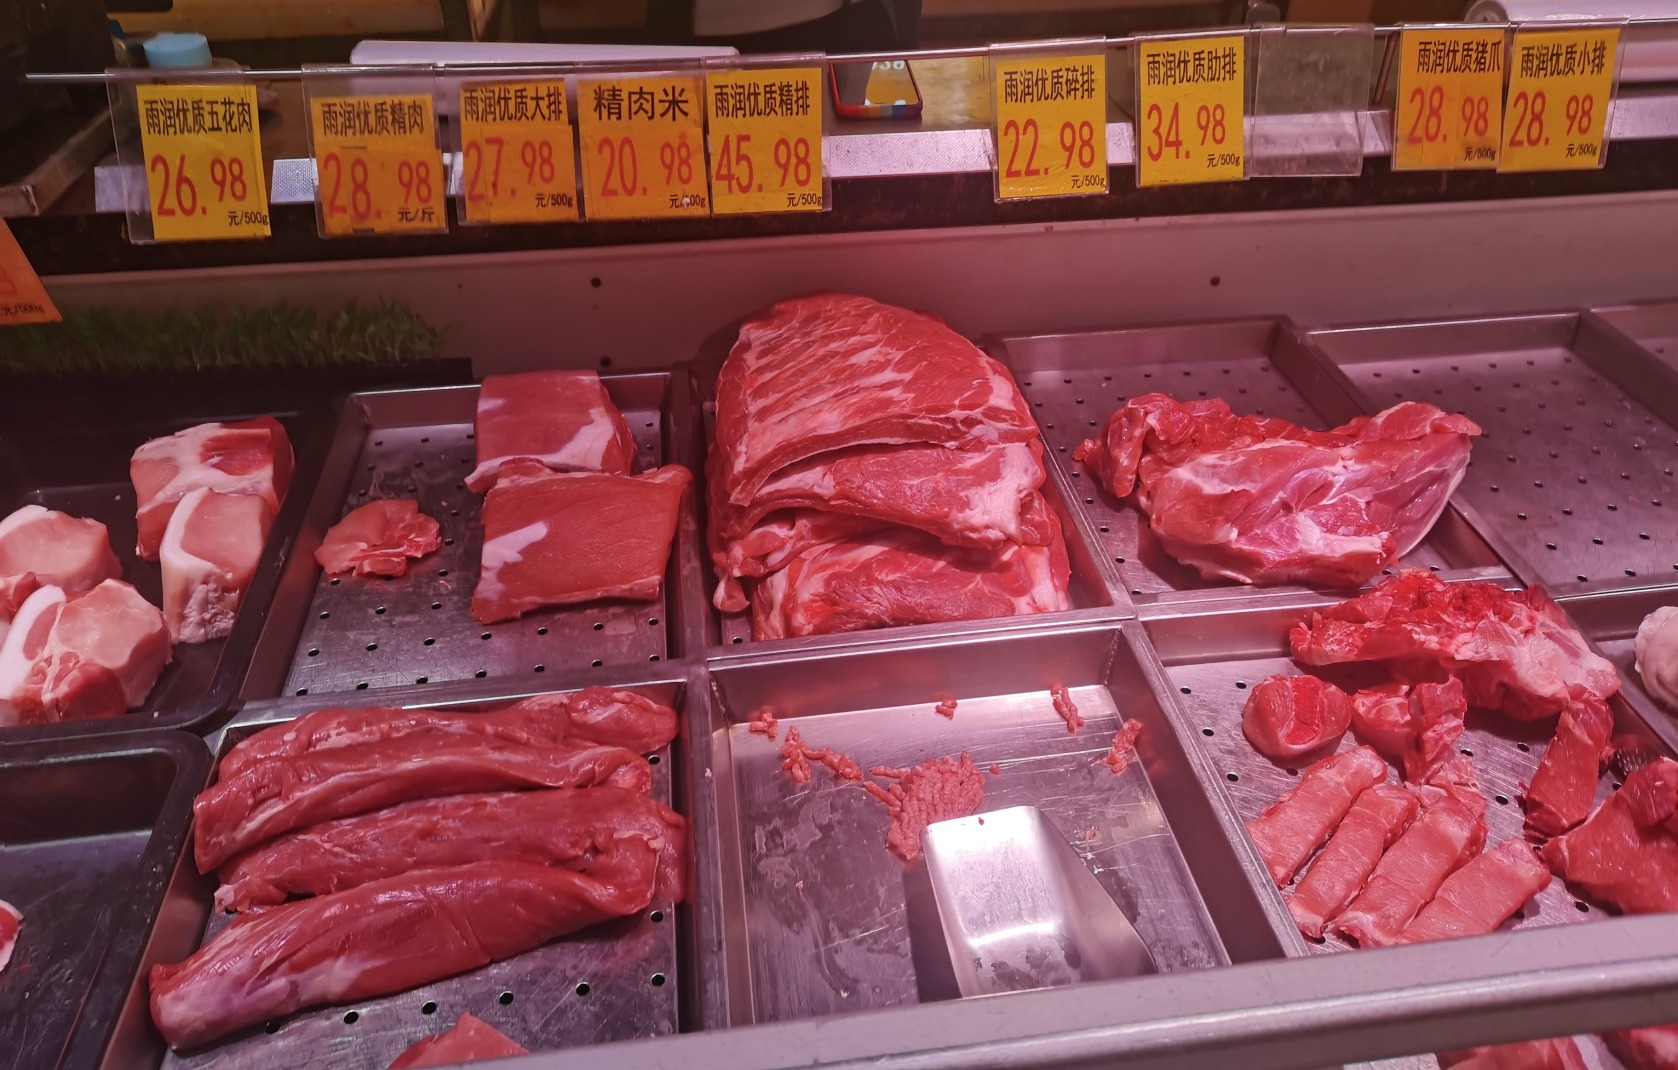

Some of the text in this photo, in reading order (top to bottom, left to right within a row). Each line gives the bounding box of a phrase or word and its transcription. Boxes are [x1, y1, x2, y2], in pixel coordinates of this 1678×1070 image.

[1147, 47, 1237, 86] 雨润优质肋排
[1417, 39, 1501, 74] 雨润优质猪爪
[1520, 40, 1607, 78] 雨润优质小排
[714, 81, 810, 118] 雨润优质精排
[1003, 64, 1095, 104] 雨润优质碎排
[143, 97, 253, 136] 雨润优质五花肉
[321, 100, 424, 136] 雨润优质精肉
[463, 86, 563, 122] 雨润优质大排
[593, 85, 689, 121] 精肉米
[1407, 85, 1489, 145] 28.98
[1509, 91, 1594, 148] 28.98
[1003, 118, 1095, 178] 22.98
[1146, 102, 1226, 162] 34.98
[464, 137, 555, 202] 27.98
[598, 136, 693, 197] 20.98
[715, 134, 811, 194] 45.98
[1206, 153, 1240, 169] 元/500g
[1464, 145, 1496, 161] 元/500g
[1565, 143, 1597, 159] 元/500g
[150, 154, 247, 217] 26.98
[322, 153, 432, 220] 28.98
[787, 192, 823, 207] 元/500g
[1071, 173, 1106, 189] 元/500g
[228, 210, 269, 227] 元/500g
[398, 207, 435, 223] 元/斤
[536, 193, 573, 208] 元/500g
